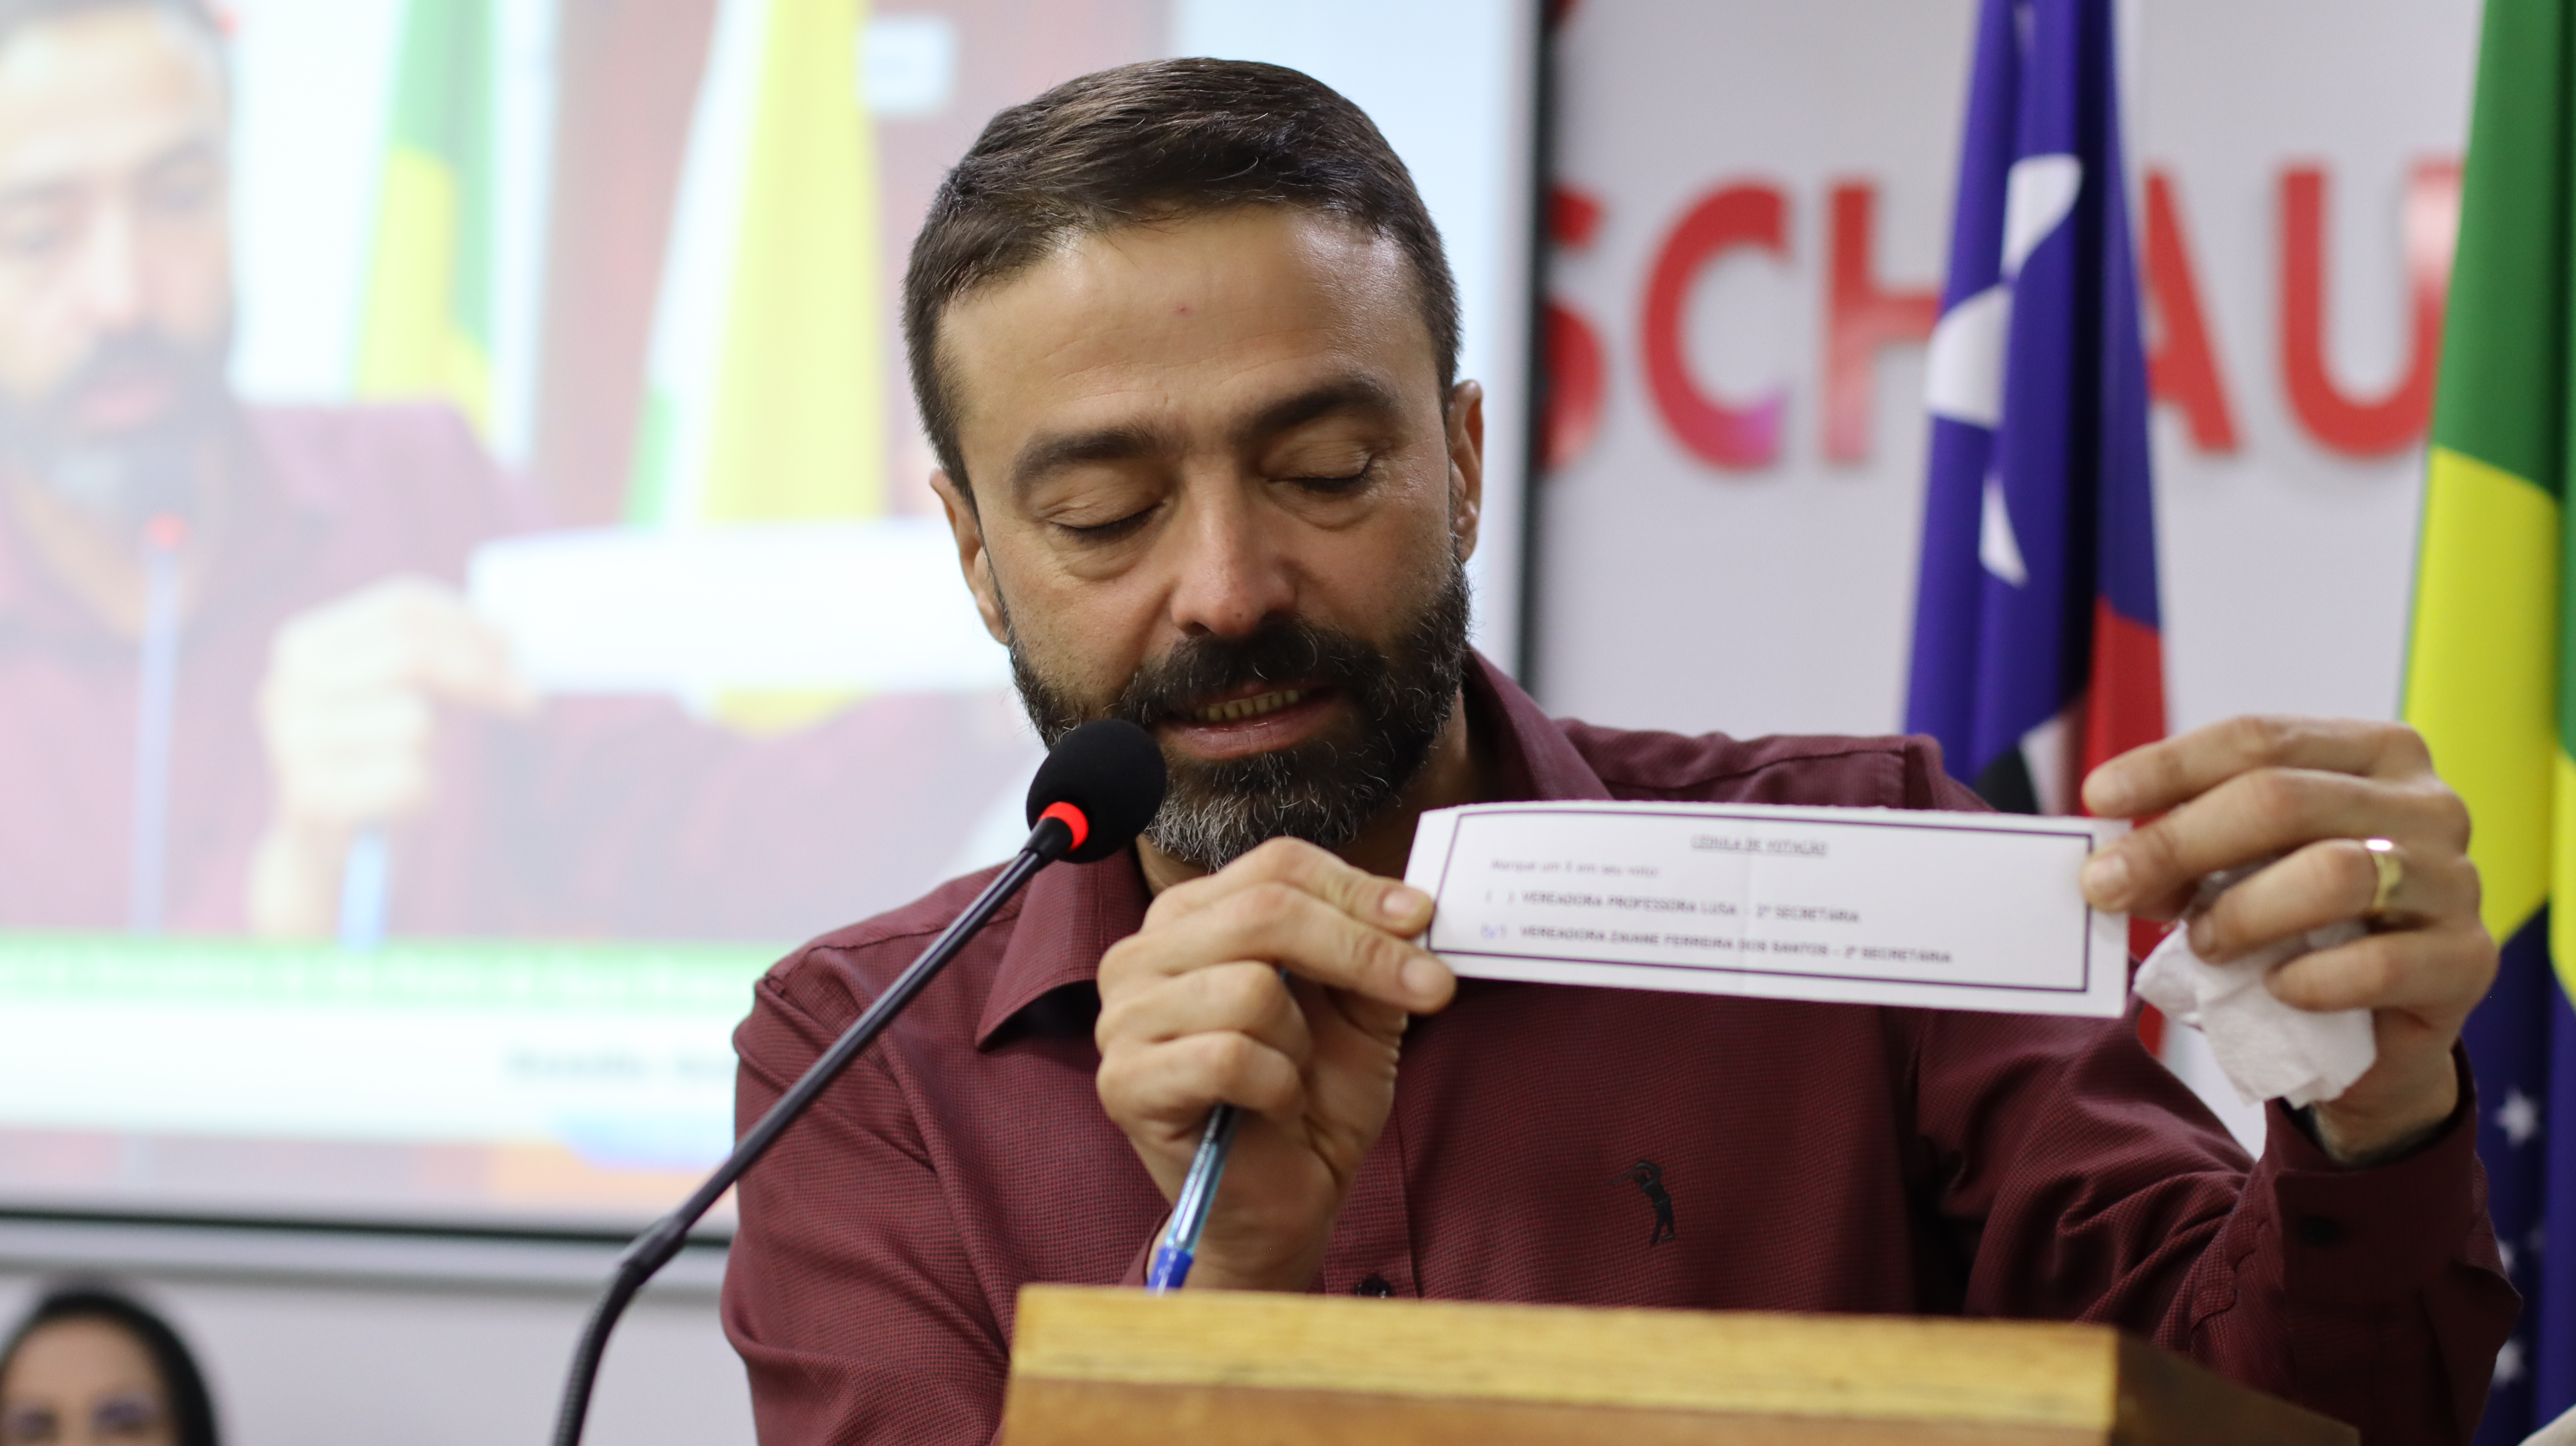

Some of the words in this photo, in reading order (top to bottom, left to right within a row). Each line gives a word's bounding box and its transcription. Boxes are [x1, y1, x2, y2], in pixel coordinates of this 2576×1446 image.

[1746, 836, 1762, 852] DE
[1491, 859, 1536, 872] Marque
[1543, 862, 1559, 872] um
[1577, 863, 1596, 872] em
[1602, 865, 1621, 876] seu
[1522, 890, 1602, 908] VEREADORA
[1607, 894, 1695, 913] PROFESSORA
[1701, 901, 1736, 915] LUSA
[1520, 924, 1605, 942] VEREADORA
[1665, 933, 1732, 950] FERREIRA
[1738, 938, 1766, 951] DOS
[1771, 940, 1829, 956] SANTOS
